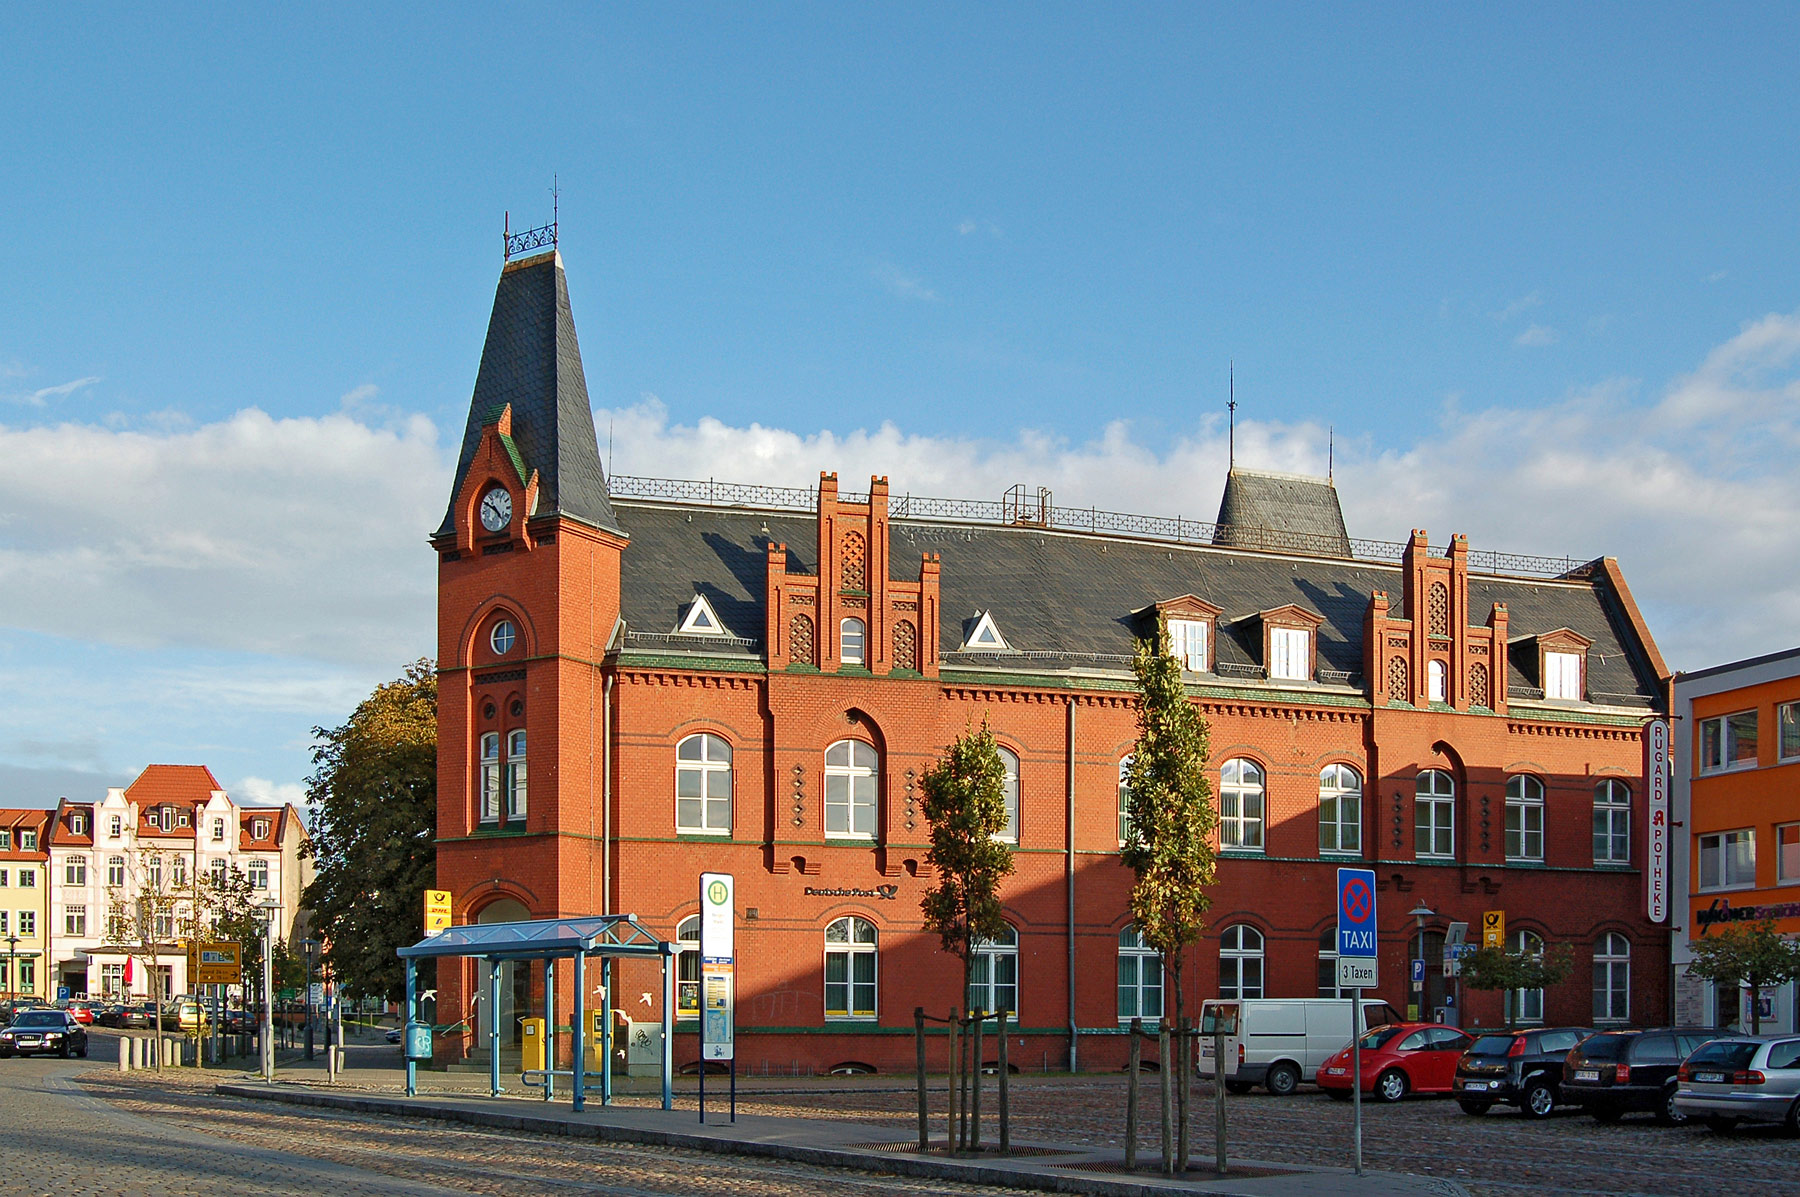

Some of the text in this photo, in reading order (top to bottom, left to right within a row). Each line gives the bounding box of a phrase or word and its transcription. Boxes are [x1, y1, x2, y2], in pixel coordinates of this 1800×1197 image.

[1652, 726, 1665, 917] RUGARD APOTHEKE
[713, 885, 723, 900] H
[804, 886, 875, 897] Deutsche Post
[1342, 930, 1373, 949] TAXI
[1343, 965, 1373, 979] 3 Taxen
[1414, 962, 1422, 978] P
[60, 988, 67, 997] P
[1446, 995, 1453, 1005] P
